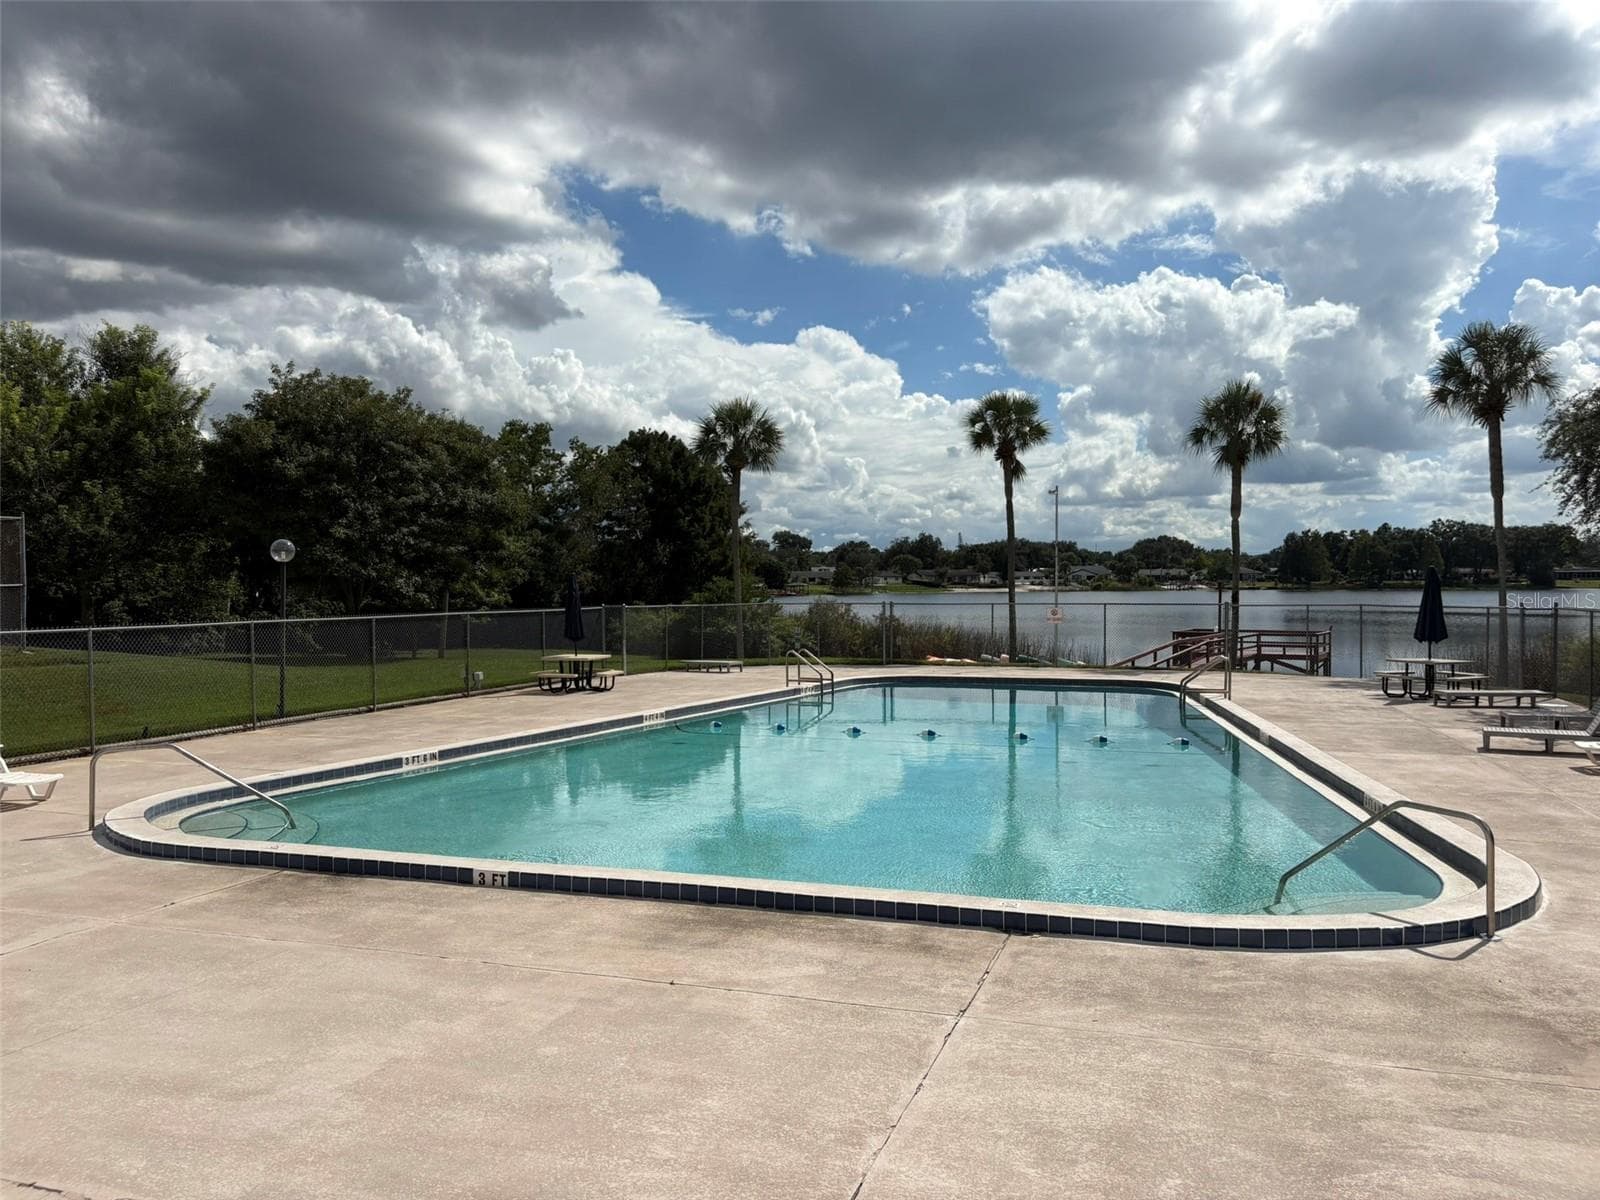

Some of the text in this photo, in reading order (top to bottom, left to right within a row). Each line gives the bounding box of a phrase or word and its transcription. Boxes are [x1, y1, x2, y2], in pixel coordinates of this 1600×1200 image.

[405, 757, 409, 766] 3
[411, 755, 420, 765] FT
[429, 752, 438, 761] IN
[478, 872, 506, 887] 3 FT
